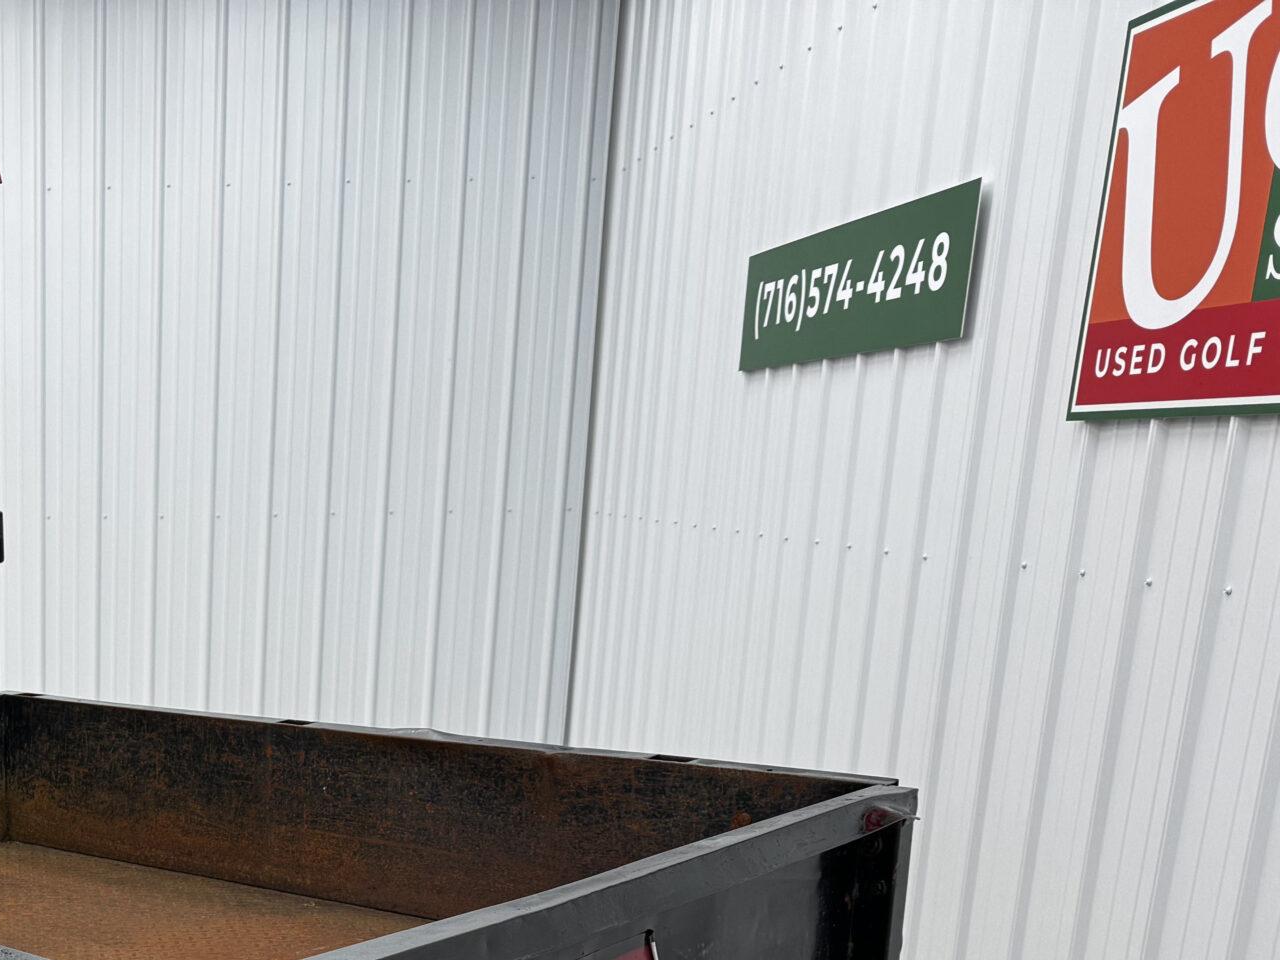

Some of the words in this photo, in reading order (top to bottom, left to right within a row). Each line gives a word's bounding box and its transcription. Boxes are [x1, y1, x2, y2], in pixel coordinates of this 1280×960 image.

[1118, 0, 1280, 330] U
[754, 231, 950, 340] (716)574-4248
[1094, 342, 1166, 378] USED
[1179, 331, 1266, 371] GOLF
